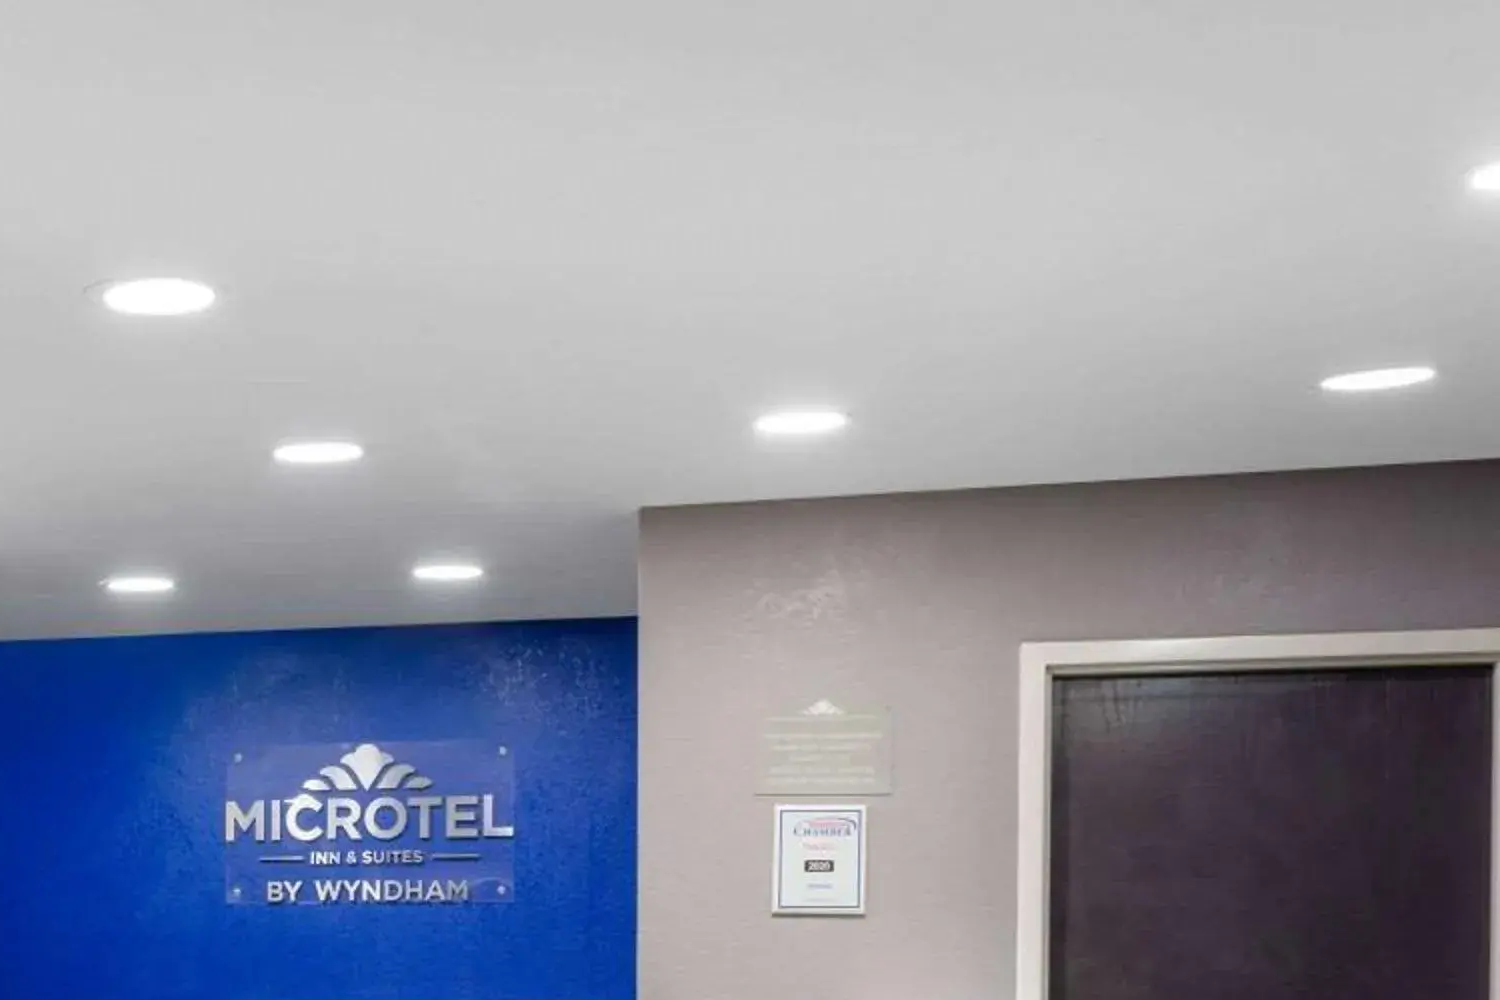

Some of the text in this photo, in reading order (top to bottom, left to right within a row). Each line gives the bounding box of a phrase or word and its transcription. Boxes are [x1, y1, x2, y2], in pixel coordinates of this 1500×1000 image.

[225, 793, 514, 842] MICROTEL
[310, 850, 423, 865] INN & SUITES
[808, 861, 831, 872] 2020
[266, 879, 469, 903] BY WYNDHAM
